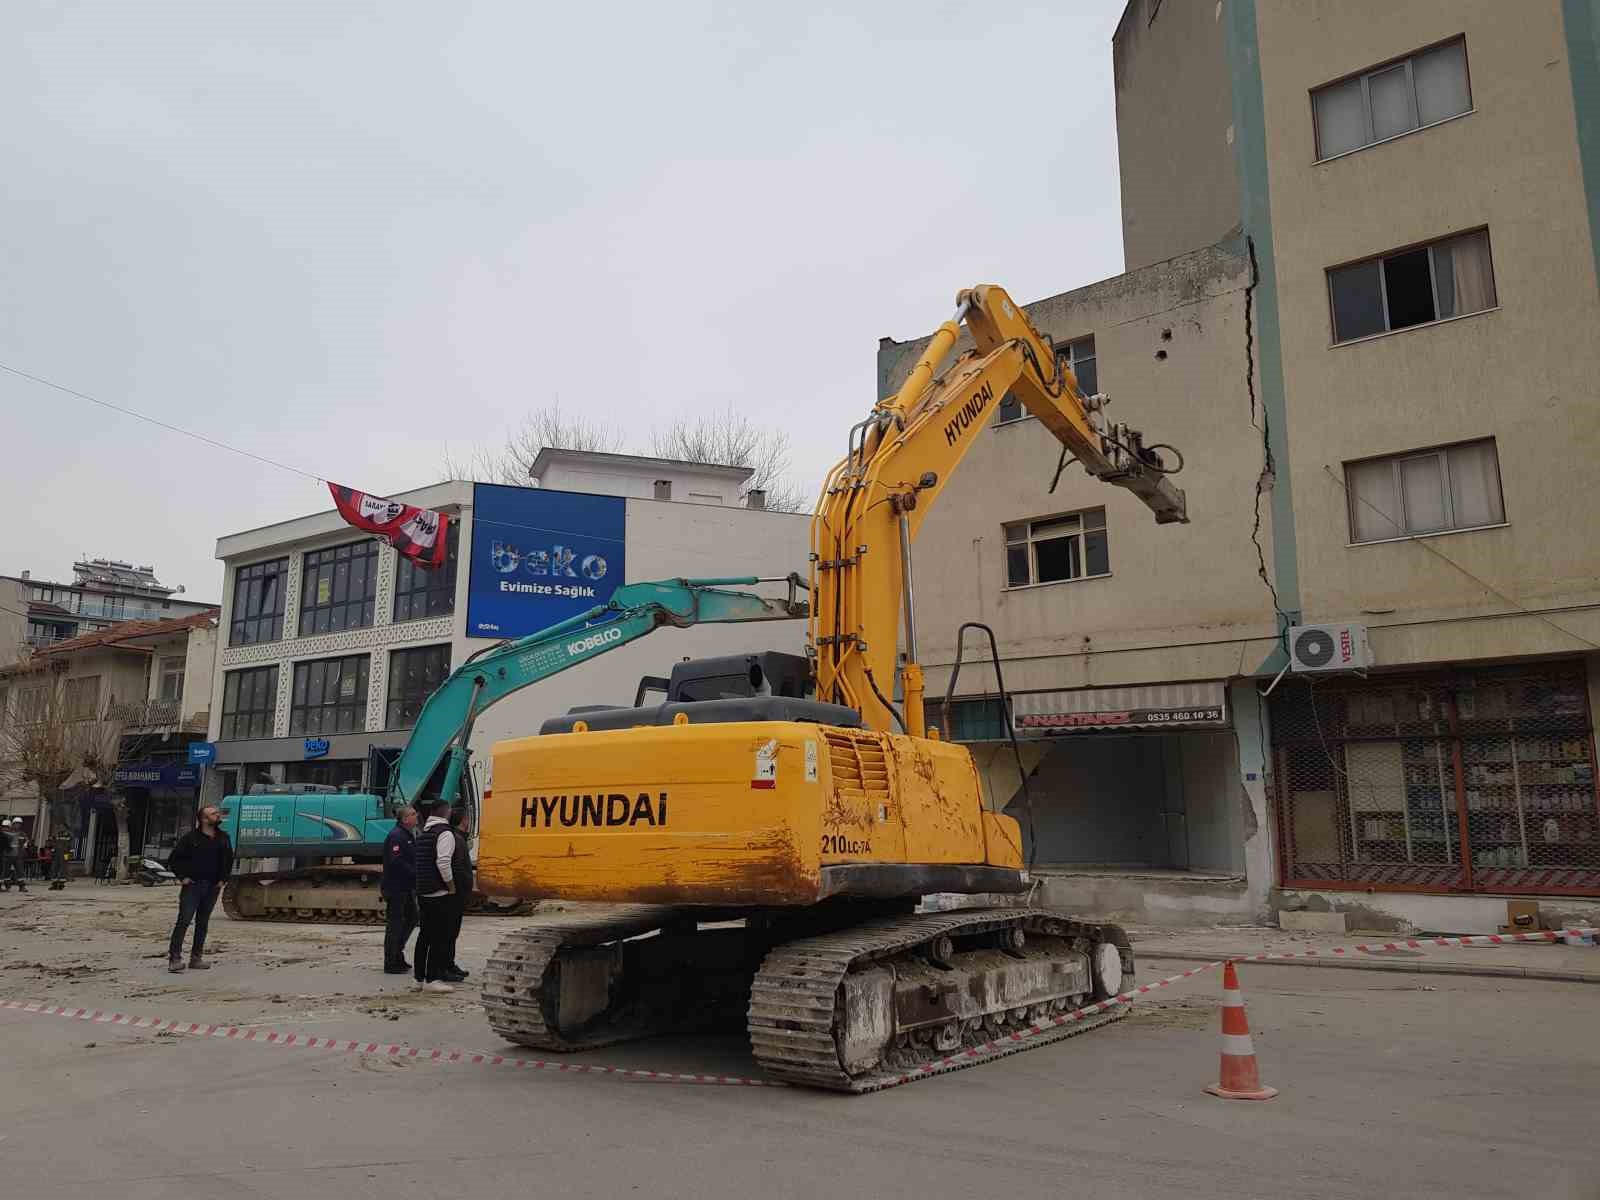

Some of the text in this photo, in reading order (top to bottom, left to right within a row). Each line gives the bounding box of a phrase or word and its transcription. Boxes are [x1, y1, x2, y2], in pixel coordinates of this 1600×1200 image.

[944, 380, 994, 447] HYUNDAI
[491, 540, 608, 580] beko
[500, 581, 595, 599] Evimize Sağlık
[567, 627, 622, 656] KOBELCO
[1340, 630, 1351, 663] VESTEL
[1147, 712, 1170, 721] 0535
[520, 793, 667, 828] HYUNDAI
